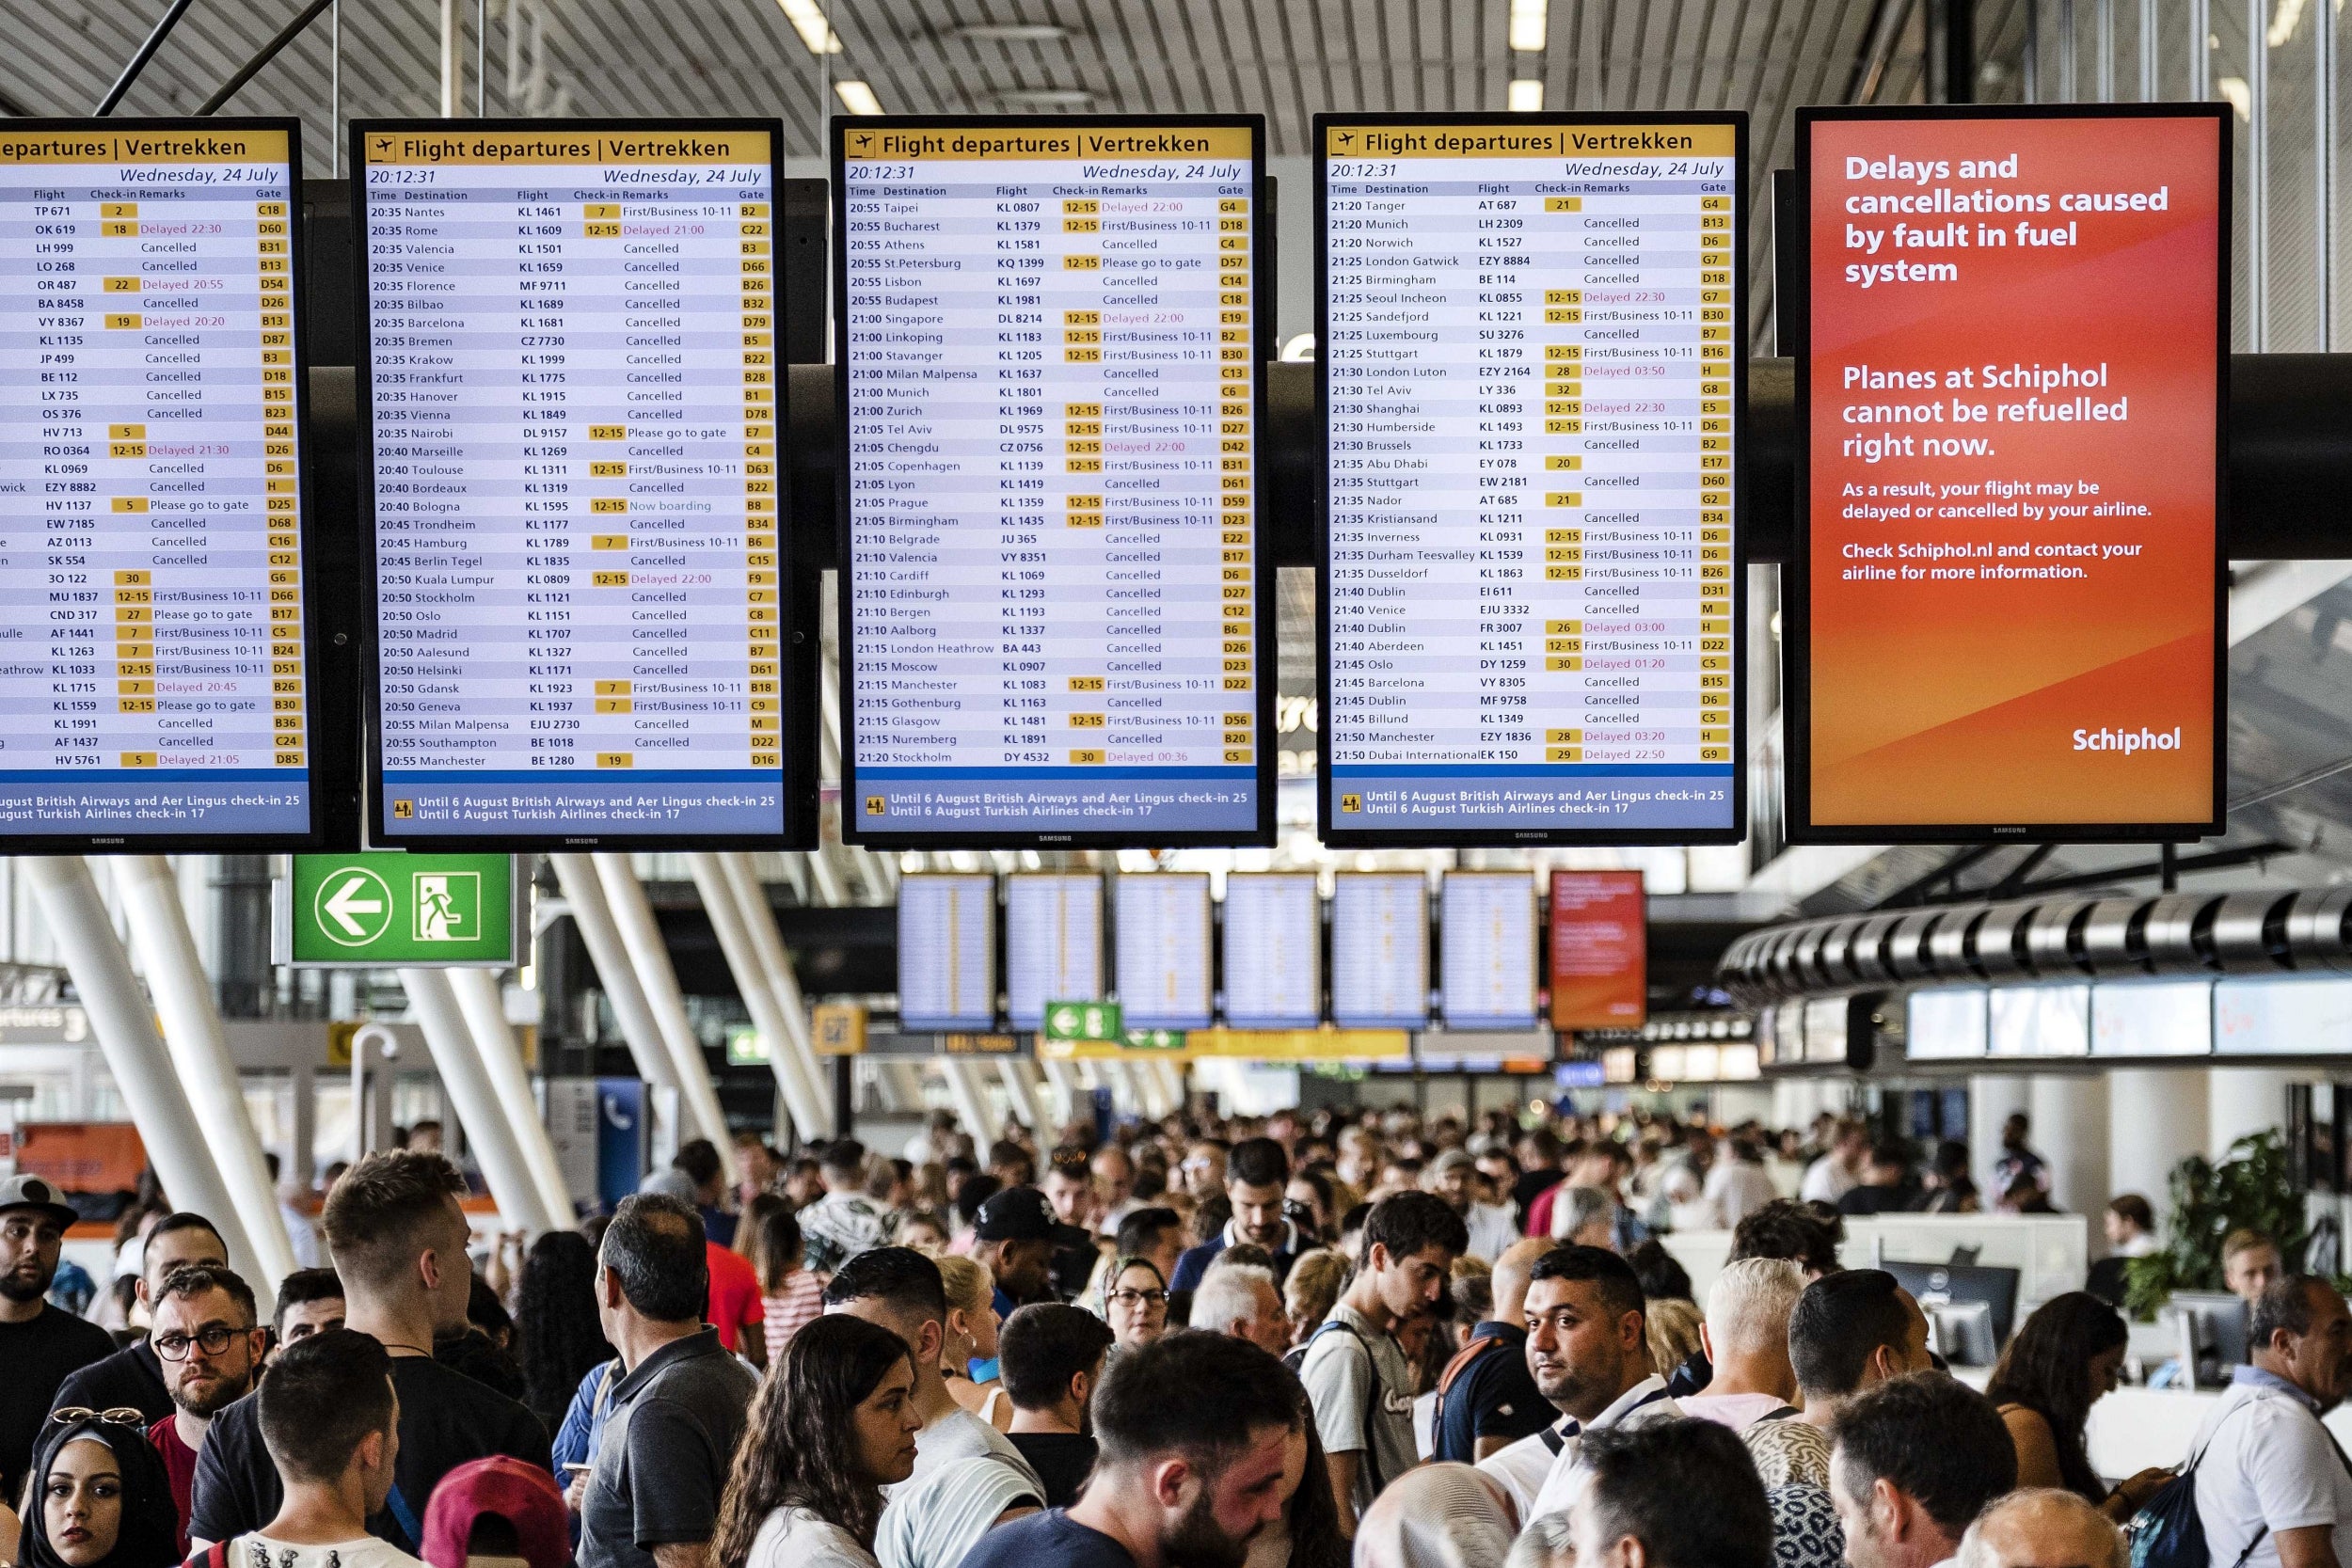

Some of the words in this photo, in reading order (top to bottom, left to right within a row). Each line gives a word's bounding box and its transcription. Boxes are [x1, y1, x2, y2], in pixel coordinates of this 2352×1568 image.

[3, 141, 106, 160] epartures
[125, 138, 245, 155] Vertrekken
[405, 140, 465, 161] Flight
[473, 140, 590, 161] departures
[610, 139, 729, 156] Vertrekken
[884, 135, 945, 157] Flight
[952, 135, 1069, 156] departures
[1089, 135, 1208, 151] Vertrekken
[1367, 134, 1426, 154] Flight
[1435, 134, 1552, 154] departures
[1572, 133, 1692, 149] Vertrekken
[120, 168, 216, 184] Wednesday,
[223, 169, 241, 181] 24
[246, 167, 278, 183] July
[371, 171, 434, 182] 20:12:31
[604, 169, 699, 185] Wednesday,
[707, 170, 724, 182] 24
[730, 169, 761, 185] July
[850, 166, 914, 179] 20:12:31
[1084, 165, 1179, 181] Wednesday,
[1185, 166, 1203, 178] 24
[1209, 165, 1241, 181] July
[1331, 165, 1395, 177] 20:12:31
[1566, 162, 1661, 178] Wednesday,
[1668, 163, 1687, 175] 24
[1692, 162, 1724, 178] July
[1847, 155, 1949, 185] Delays
[1959, 153, 2017, 178] and
[517, 191, 548, 201] Flight
[1846, 188, 2050, 214] cancellations
[2059, 186, 2168, 211] caused
[372, 208, 401, 216] 20:35
[405, 208, 444, 216] Nantes
[518, 208, 532, 216] KL
[536, 208, 560, 216] 1461
[624, 207, 698, 215] First/Business
[703, 207, 730, 215] 10-11
[742, 207, 755, 215] B2
[36, 226, 52, 234] OK
[56, 226, 75, 234] 619
[114, 225, 126, 233] 18
[141, 224, 186, 235] Delayed
[192, 225, 221, 233] 22:30
[1847, 224, 1884, 254] by
[1893, 223, 1968, 247] fault
[1979, 223, 2006, 246] in
[2015, 221, 2076, 245] fuel
[851, 241, 880, 249] 20:55
[884, 240, 924, 249] Athens
[1103, 239, 1157, 248] Cancelled
[1221, 240, 1234, 248] C4
[1846, 260, 1957, 286] system
[1332, 294, 1361, 303] 21:25
[1366, 293, 1396, 303] Seoul
[1402, 293, 1446, 302] Incheon
[1480, 293, 1493, 302] KL
[1496, 293, 1522, 302] 0855
[1549, 293, 1578, 302] 12-15
[1584, 293, 1629, 304] Delayed
[1636, 293, 1665, 301] 22:30
[1703, 293, 1718, 301] G7
[1845, 365, 1936, 388] Planes
[1946, 368, 1974, 388] at
[1983, 363, 2106, 393] Schiphol
[1843, 402, 1944, 422] cannot
[1953, 399, 1988, 422] be
[1998, 397, 2127, 421] refuelled
[1844, 433, 1914, 463] right
[1924, 439, 1994, 456] now.
[1843, 483, 1863, 496] As
[1868, 486, 1877, 496] a
[1883, 482, 1935, 497] result,
[1941, 485, 1980, 499] your
[1985, 481, 2031, 499] flight
[2037, 484, 2073, 498] may
[2078, 480, 2099, 494] be
[46, 501, 62, 510] HV
[67, 501, 91, 510] 1137
[127, 501, 133, 510] 5
[151, 500, 185, 509] Please
[189, 503, 203, 512] go
[224, 501, 248, 512] gate
[269, 500, 290, 509] D25
[1843, 503, 1910, 521] delayed
[1915, 508, 1933, 517] or
[1938, 502, 2017, 517] cancelled
[2024, 502, 2043, 520] by
[2049, 506, 2089, 520] your
[2093, 501, 2151, 515] airline.
[1843, 544, 1893, 558] Check
[1899, 543, 1992, 561] Schiphol.nl
[1997, 542, 2029, 557] and
[2035, 544, 2097, 556] contact
[2103, 546, 2142, 559] your
[1843, 565, 1896, 579] airline
[1901, 565, 1926, 579] for
[1931, 568, 1975, 578] more
[1981, 564, 2087, 578] information.
[382, 576, 411, 584] 20:50
[416, 575, 447, 584] Kuala
[452, 576, 494, 586] Lumpur
[596, 575, 626, 583] 12-15
[631, 574, 676, 585] Delayed
[682, 575, 711, 583] 22:00
[1335, 606, 1364, 614] 21:40
[1368, 606, 1406, 614] Venice
[1481, 606, 1500, 614] EJU
[1585, 605, 1639, 613] Cancelled
[858, 644, 886, 653] 21:15
[891, 644, 933, 653] London
[938, 644, 993, 653] Heathrow
[1003, 644, 1018, 653] BA
[1022, 644, 1041, 653] 443
[1107, 643, 1161, 653] Cancelled
[1225, 643, 1246, 652] D26
[73, 737, 98, 746] 1437
[159, 736, 213, 746] Cancelled
[276, 736, 296, 745] C24
[2074, 727, 2180, 754] Schiphol
[0, 798, 32, 808] ugust
[37, 796, 75, 806] British
[81, 796, 130, 808] Airways
[135, 796, 156, 805] and
[162, 797, 183, 805] Aer
[187, 796, 227, 808] Lingus
[231, 795, 280, 805] check-in
[286, 796, 299, 805] 25
[420, 797, 448, 806] Until
[453, 798, 459, 806] 6
[464, 798, 507, 809] August
[513, 797, 550, 806] British
[556, 797, 605, 808] Airways
[610, 797, 632, 806] and
[637, 797, 658, 806] Aer
[663, 797, 702, 808] Lingus
[707, 796, 755, 806] check-in
[761, 797, 774, 805] 25
[420, 809, 448, 818] Until
[453, 810, 459, 818] 6
[464, 810, 508, 821] August
[512, 809, 555, 818] Turkish
[561, 809, 607, 818] Airlines
[612, 809, 660, 818] check-in
[667, 809, 679, 818] 17
